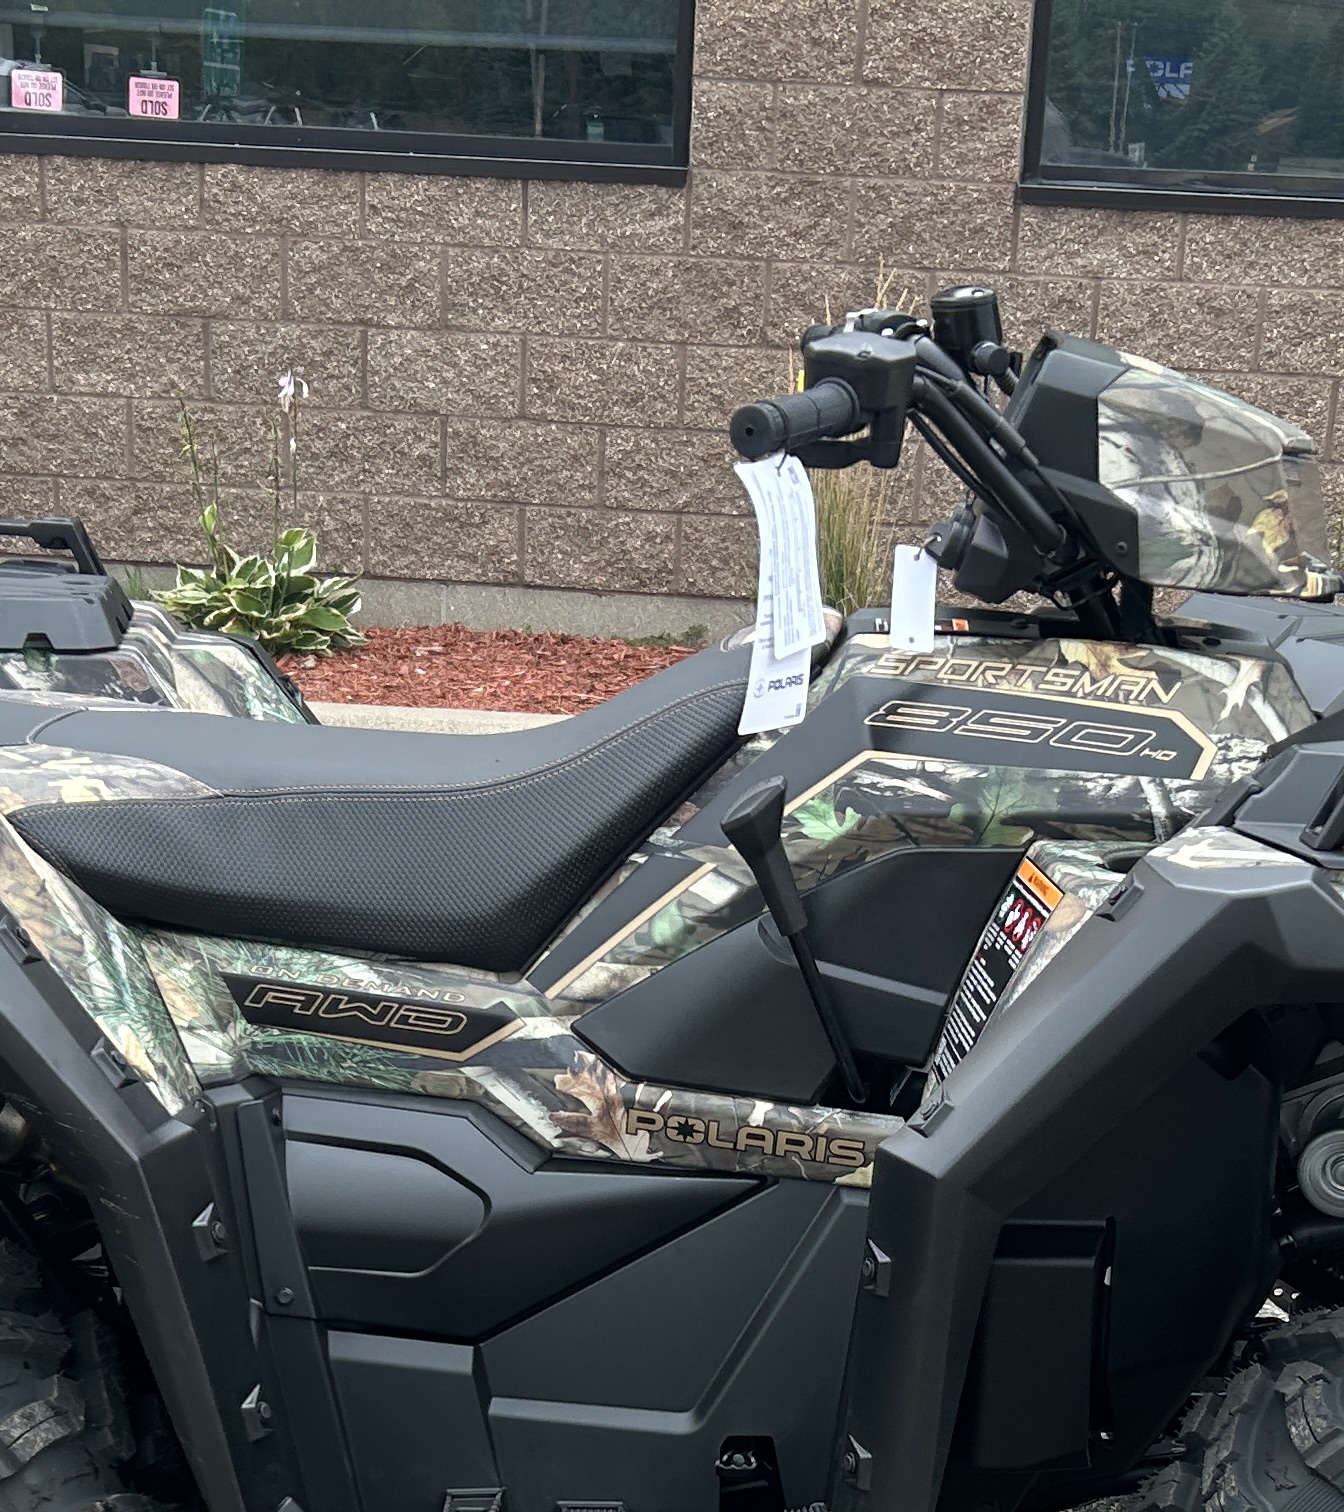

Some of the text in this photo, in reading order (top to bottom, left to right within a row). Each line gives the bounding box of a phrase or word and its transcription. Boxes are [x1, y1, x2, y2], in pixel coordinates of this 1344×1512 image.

[24, 92, 52, 108] SOLD
[140, 99, 168, 116] SOLD
[768, 674, 805, 692] POLARIS
[868, 652, 1183, 705] SPORTSMAN
[863, 700, 1157, 756] 850
[250, 965, 468, 1002] ON DEMAND
[244, 983, 468, 1036] AWD
[626, 1108, 866, 1167] POLARIS
